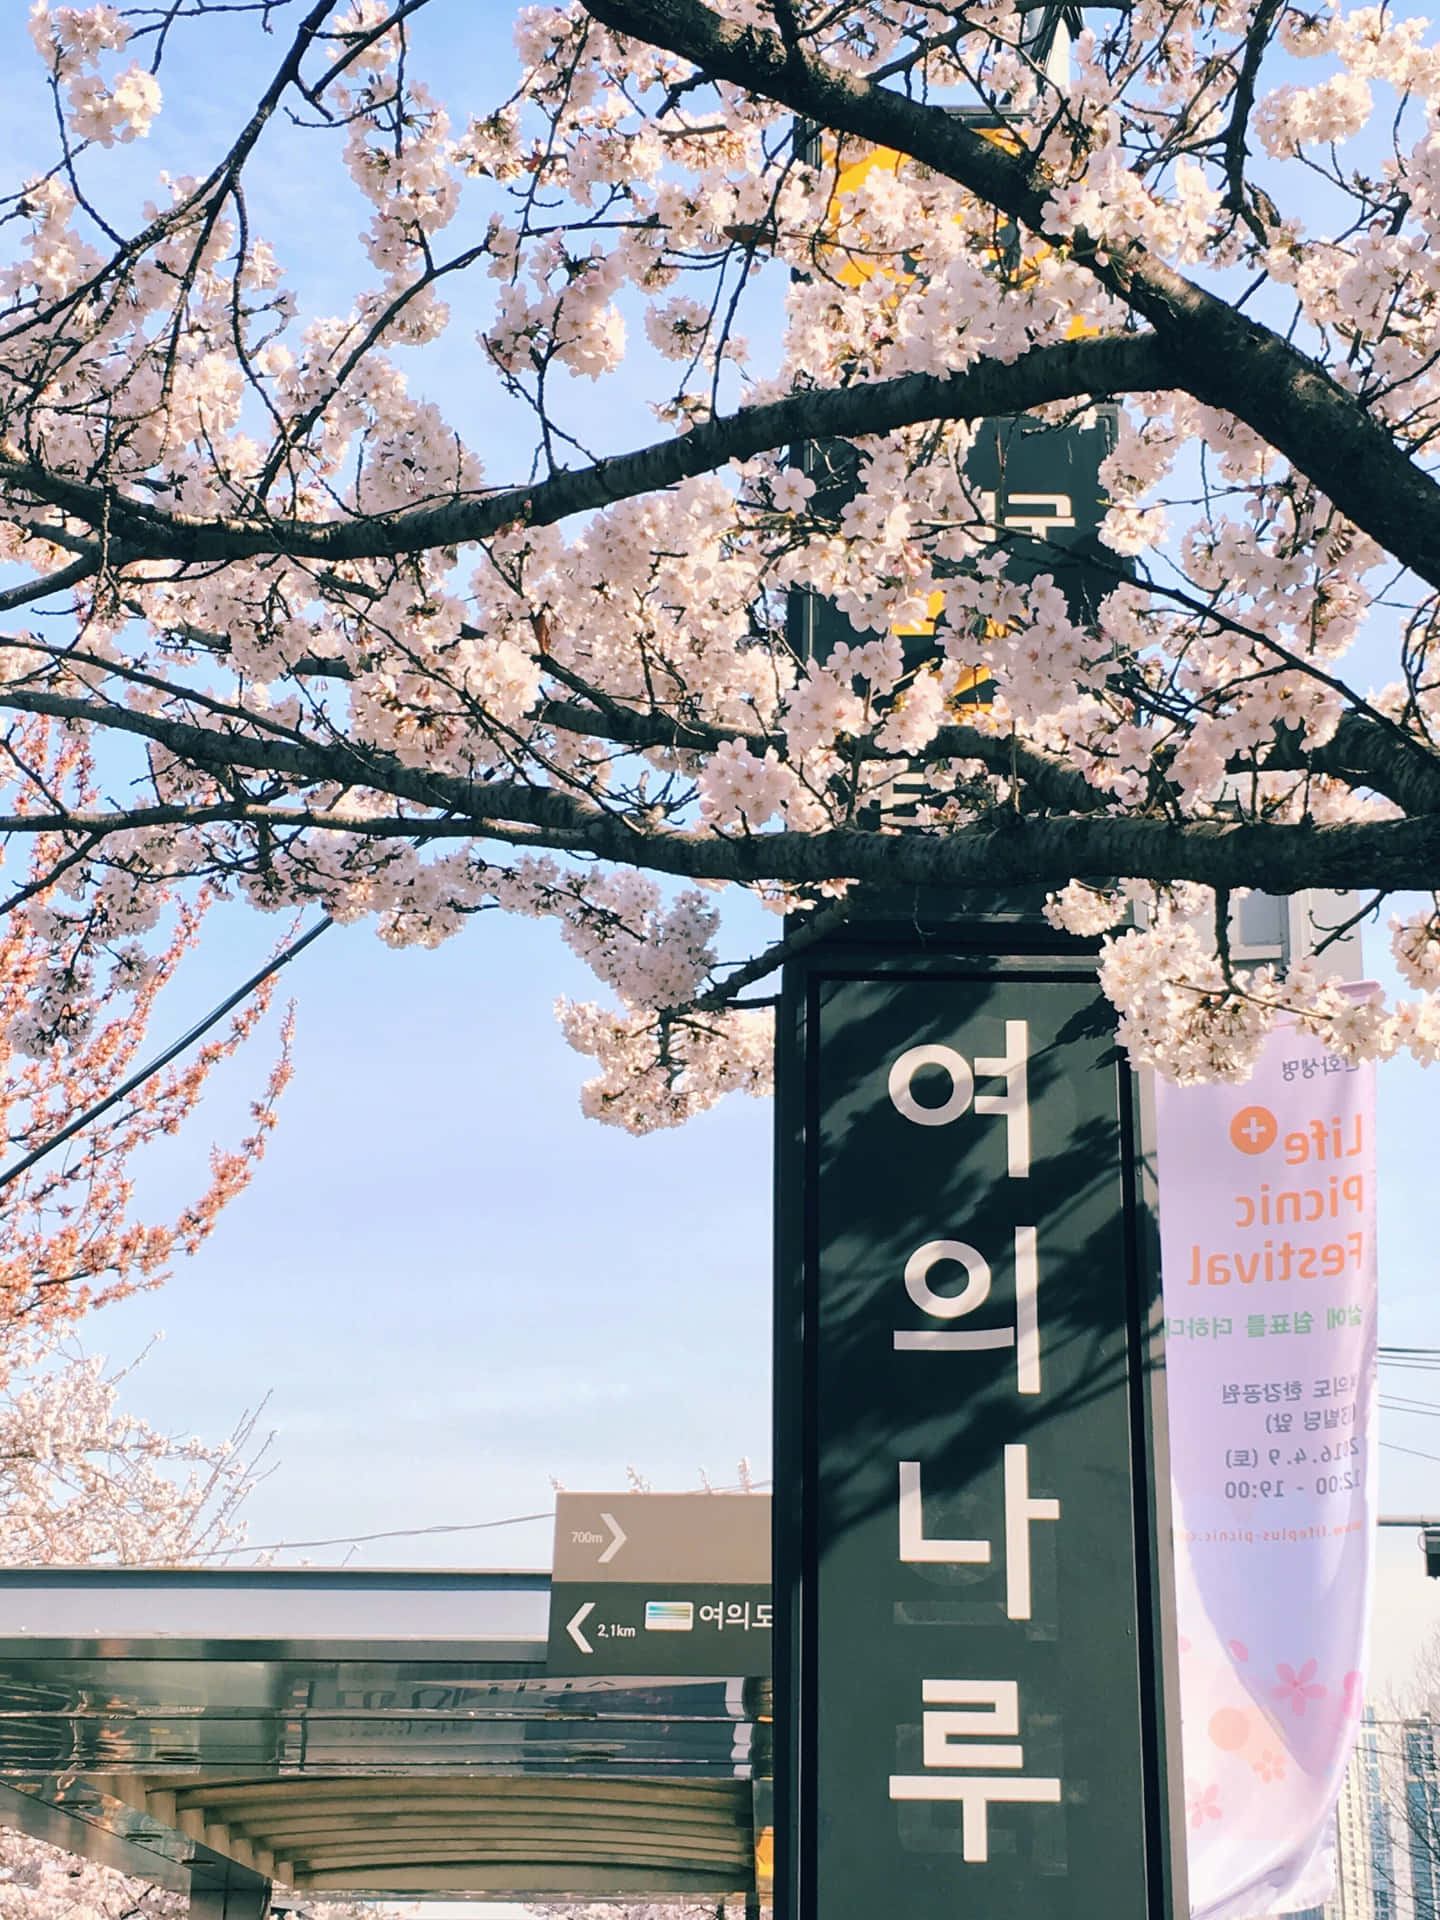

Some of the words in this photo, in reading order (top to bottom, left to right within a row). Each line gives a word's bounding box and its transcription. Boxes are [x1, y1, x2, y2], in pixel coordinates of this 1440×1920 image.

[888, 1020, 1061, 1862] 여의나루
[571, 1531, 604, 1544] 700m
[597, 1624, 636, 1638] 2.1km
